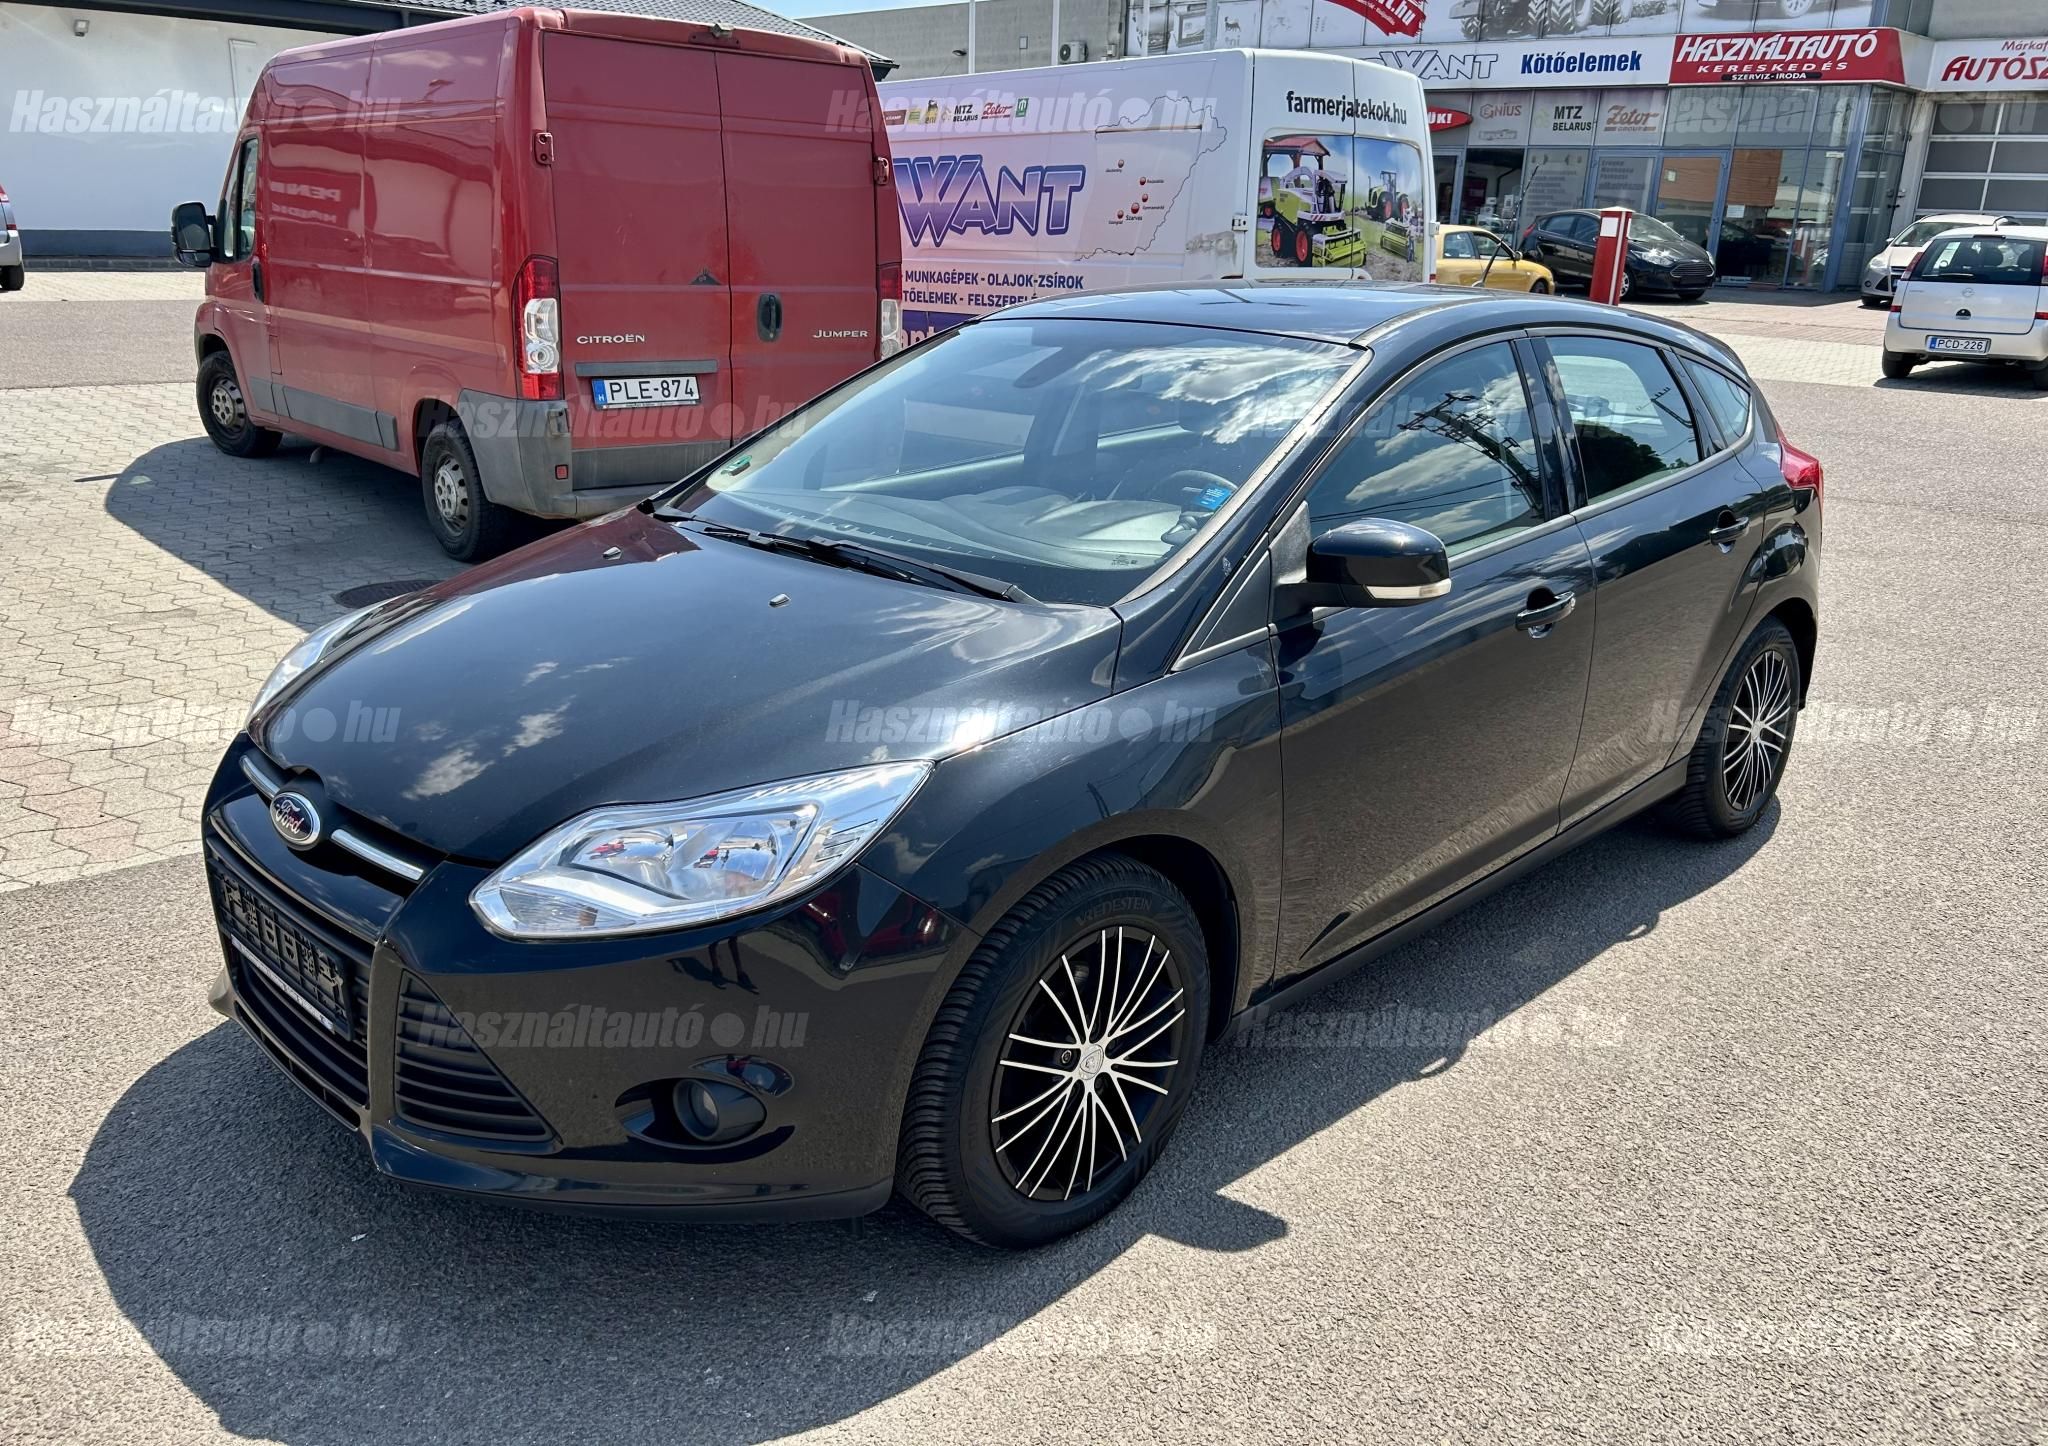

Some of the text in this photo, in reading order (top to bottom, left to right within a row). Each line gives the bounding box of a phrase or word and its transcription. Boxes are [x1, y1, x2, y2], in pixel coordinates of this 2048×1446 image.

[1675, 30, 1879, 63] HASZNÁLTAUTÓ
[1520, 50, 1642, 75] Kötőelemek
[1697, 61, 1849, 74] KERESKEDÉS
[1731, 73, 1807, 81] SZERVIZ-IRODA
[954, 104, 974, 115] MTZ
[1286, 91, 1407, 125] farmerjatekok.hu
[1554, 105, 1583, 120] MTZ
[1606, 104, 1659, 125] Zetor
[953, 114, 978, 123] BELARUS
[1552, 122, 1592, 131] BELARUS
[905, 269, 979, 286] MUNKAGÉPEK
[987, 272, 1084, 289] OLAJOK-ZSÍROK
[576, 333, 646, 344] CITROËN
[812, 329, 869, 338] JUMPER
[1937, 339, 1983, 351] PCD-226
[609, 379, 694, 401] PLE-874
[276, 799, 305, 835] Ford
